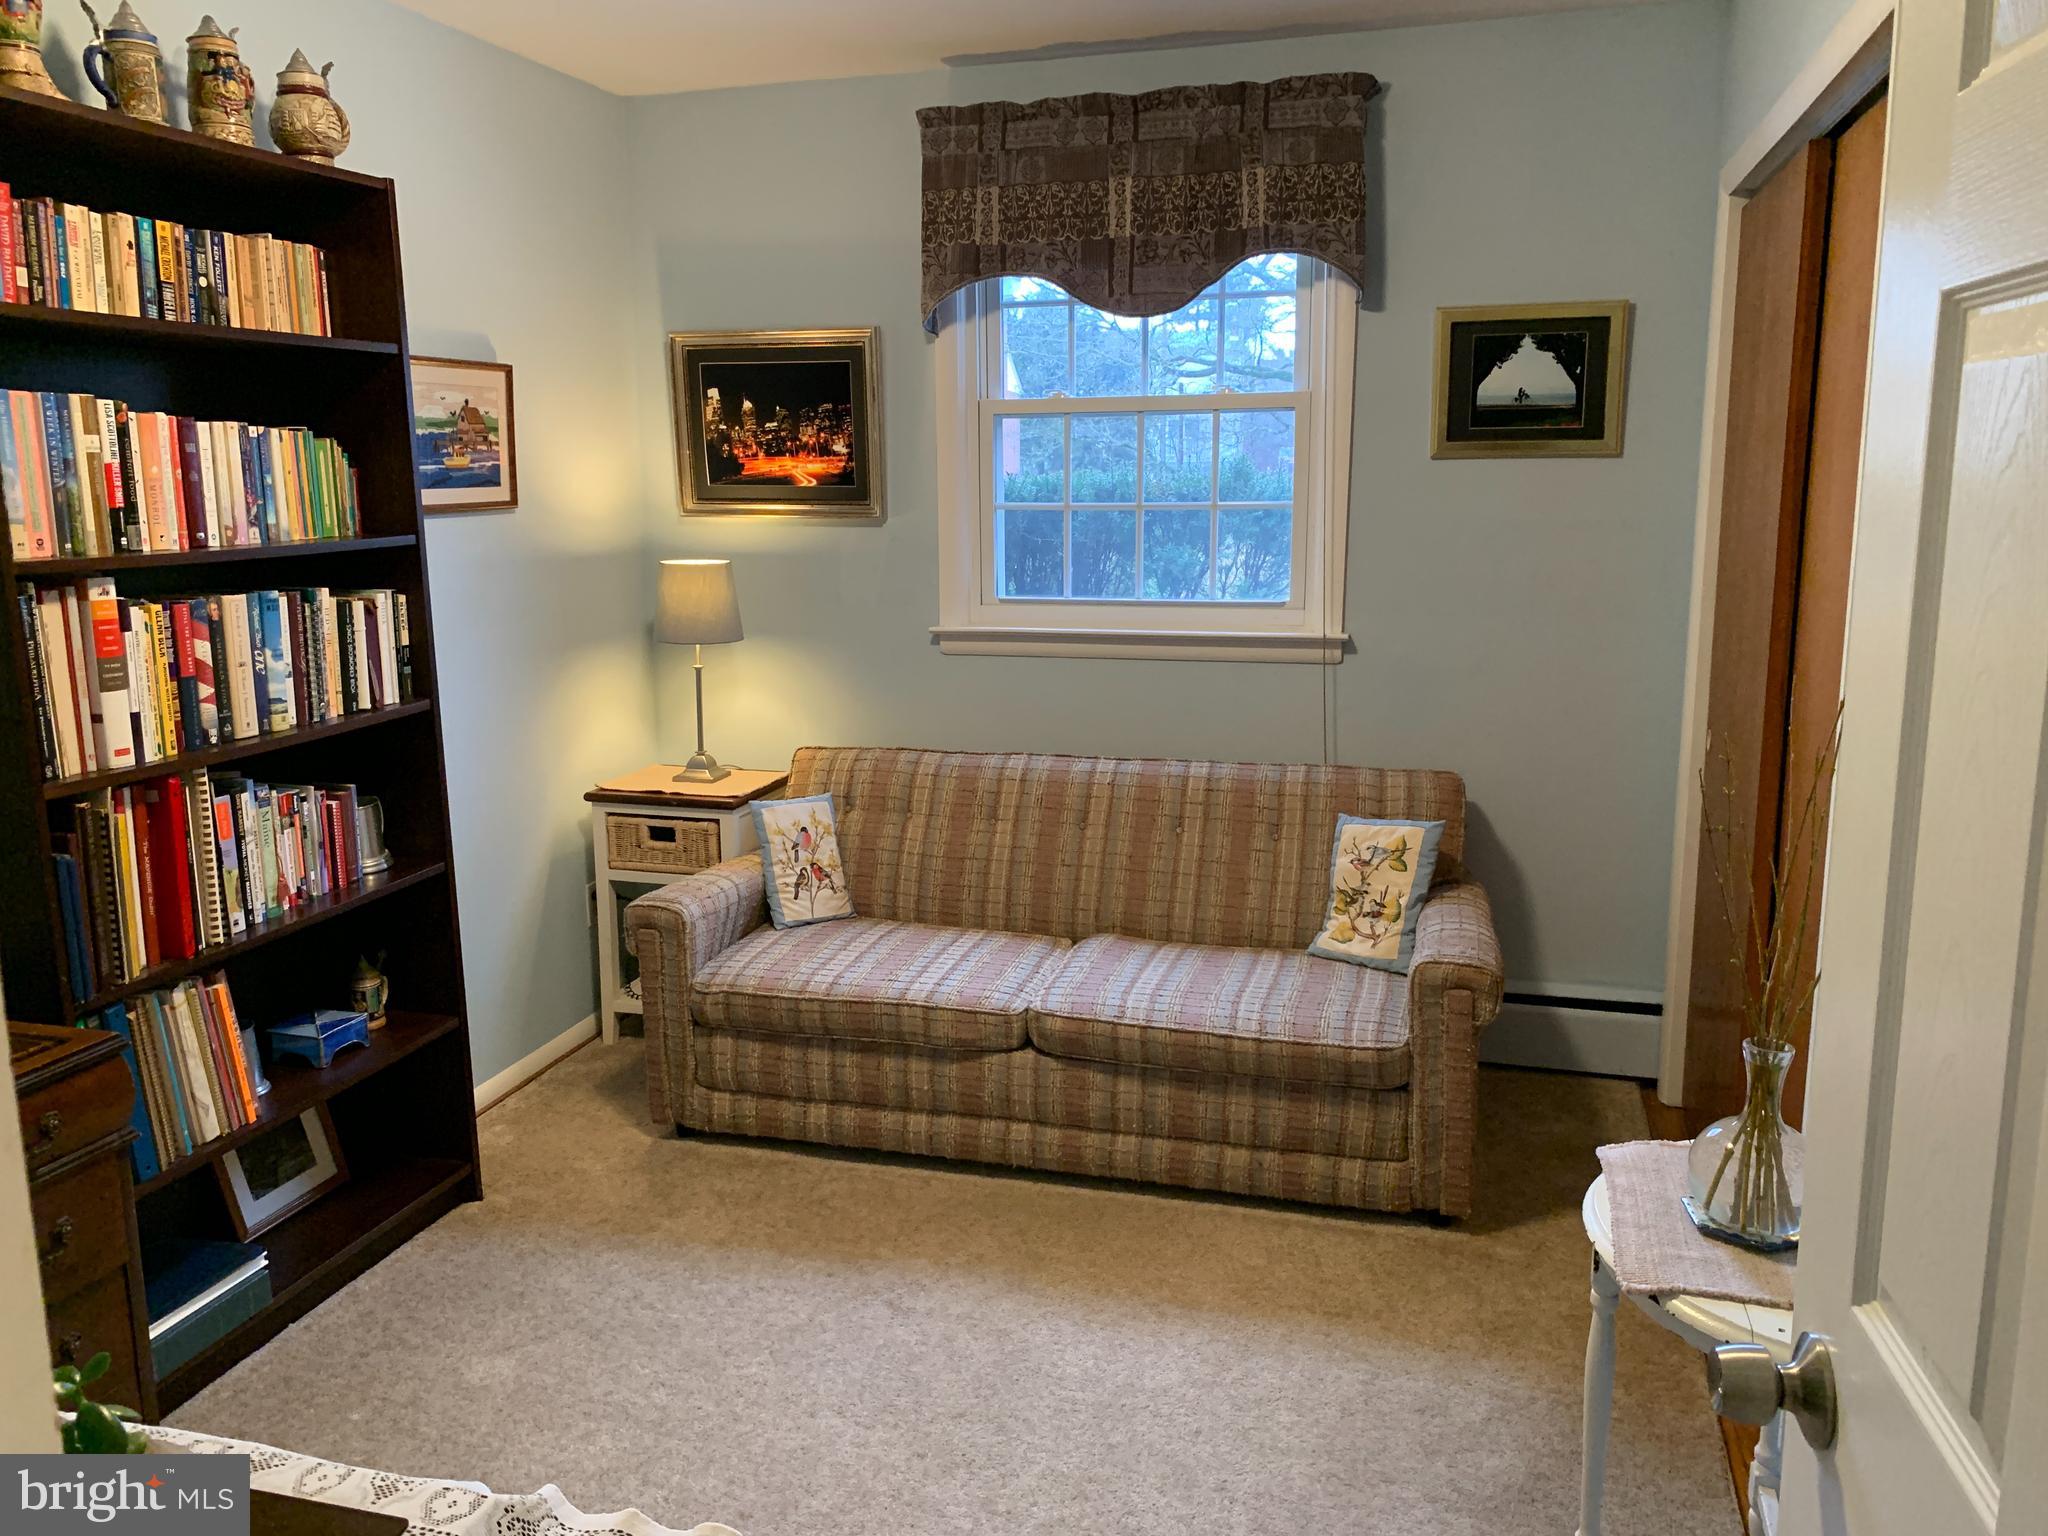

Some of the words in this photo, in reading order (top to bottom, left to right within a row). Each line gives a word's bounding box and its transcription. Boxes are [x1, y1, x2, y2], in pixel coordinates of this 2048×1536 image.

[0, 214, 10, 245] DAVID
[160, 235, 170, 257] MICHAEL
[3, 247, 14, 295] BALDACCI
[214, 263, 222, 293] FOLLETT
[46, 410, 54, 434] WEEK
[104, 403, 112, 419] LISA
[49, 436, 55, 447] IN
[107, 420, 120, 461] SCOTTOLINE
[51, 450, 61, 484] WINTER
[125, 438, 134, 477] comfort
[112, 462, 122, 487] KILLER
[115, 488, 125, 509] SMILE
[129, 480, 137, 502] food
[155, 610, 164, 636] GLENN
[296, 606, 304, 632] PURPOSE
[27, 640, 42, 701] PHILADELPHIA
[260, 809, 271, 849] Maine
[237, 810, 245, 837] RAMSEY
[245, 881, 253, 910] MAKEOVER
